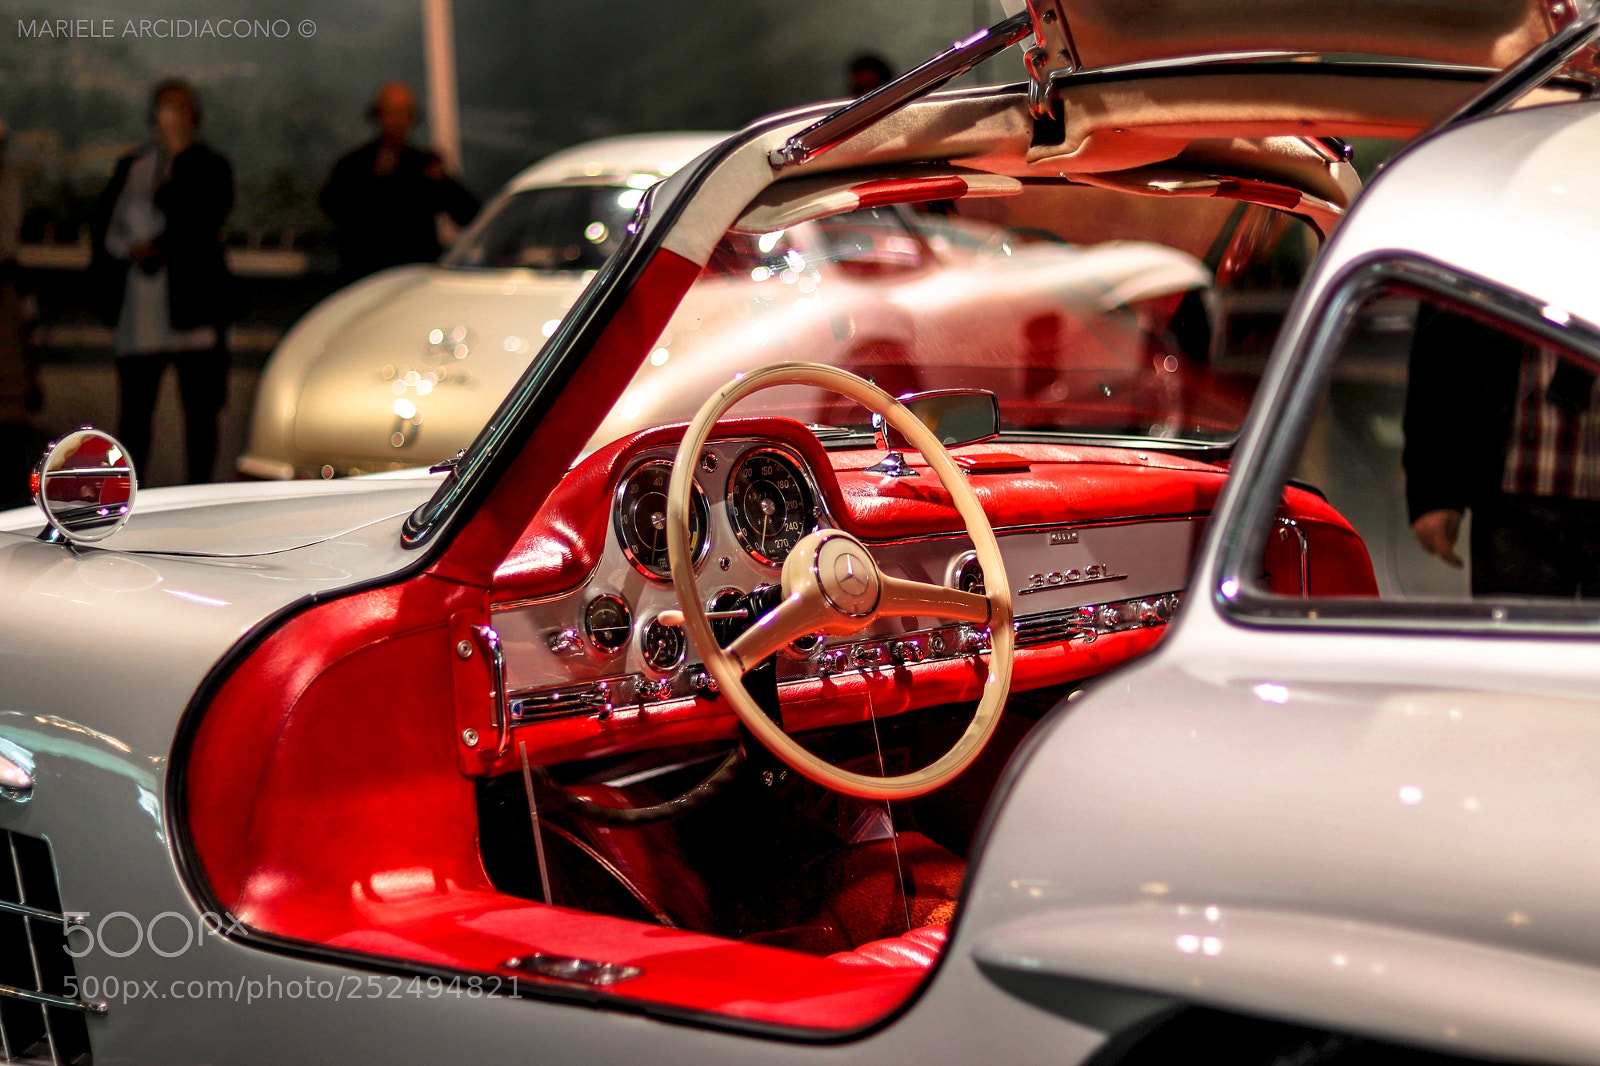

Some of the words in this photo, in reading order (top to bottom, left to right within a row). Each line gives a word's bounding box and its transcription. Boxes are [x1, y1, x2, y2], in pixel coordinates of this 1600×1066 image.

[761, 466, 773, 475] 150
[653, 477, 664, 487] 40
[777, 479, 790, 489] 180
[630, 484, 639, 494] 30
[786, 501, 798, 510] 210
[785, 521, 799, 532] 240
[774, 538, 790, 549] 270
[631, 544, 639, 554] 10
[1028, 569, 1081, 588] 300
[1084, 563, 1117, 579] SL
